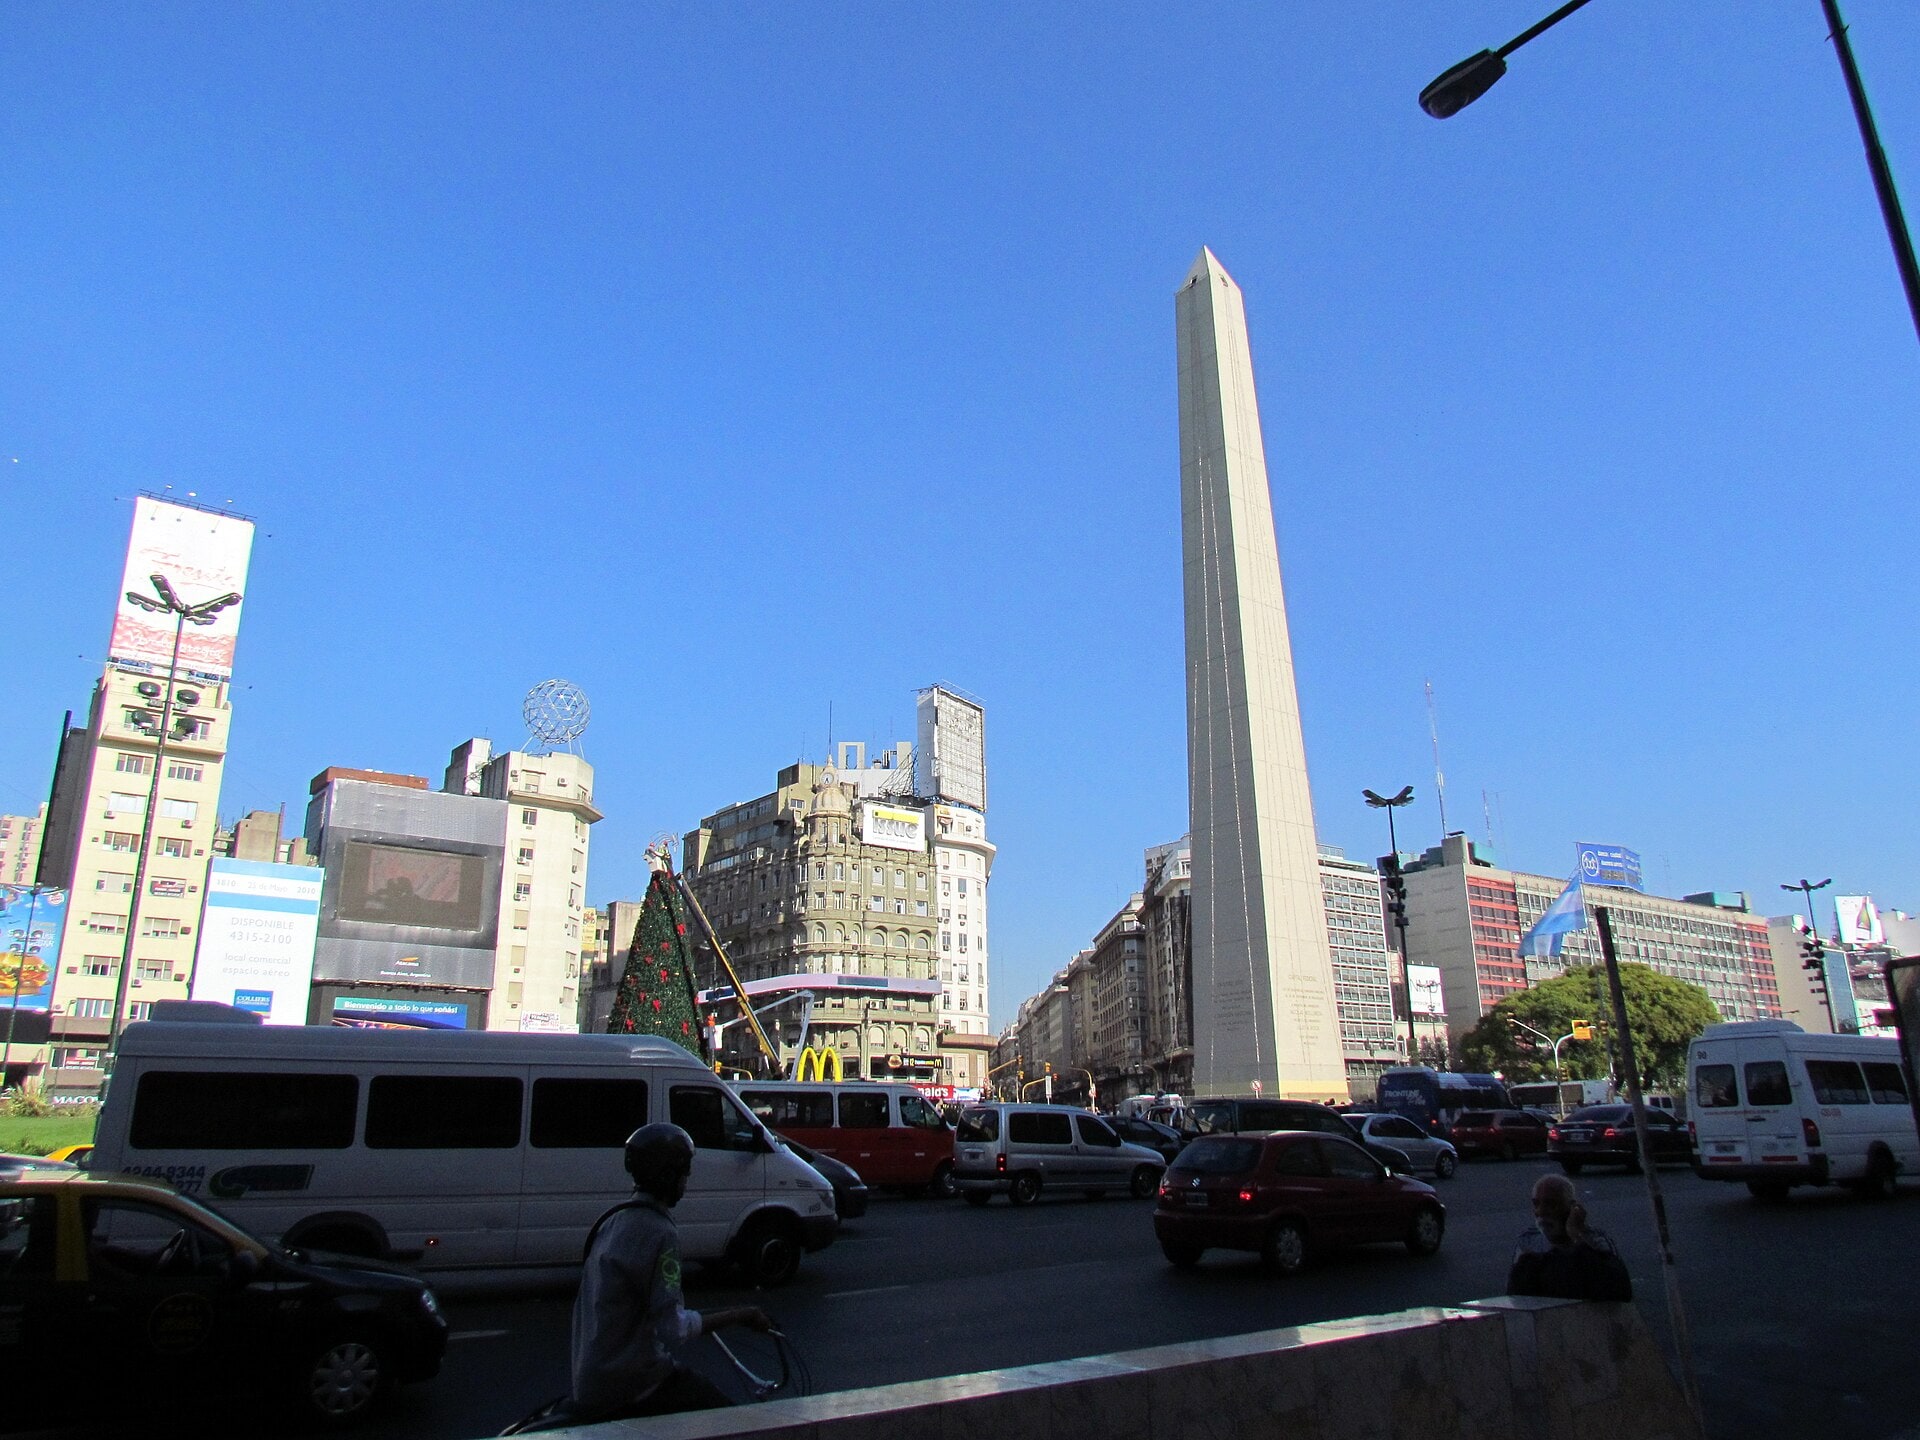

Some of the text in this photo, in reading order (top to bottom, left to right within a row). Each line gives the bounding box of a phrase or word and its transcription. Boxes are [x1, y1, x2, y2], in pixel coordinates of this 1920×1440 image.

[216, 879, 237, 888] 1810
[258, 883, 267, 891] de
[268, 883, 289, 894] Mayo
[296, 886, 316, 895] 2010
[230, 917, 295, 930] DISPONIBLE
[229, 931, 293, 945] 4315-2100
[224, 952, 292, 965] local comercial
[222, 966, 260, 977] espacio
[343, 1001, 387, 1011] Bienvenido
[387, 1004, 393, 1012] a
[394, 1003, 411, 1012] todo
[412, 1005, 419, 1013] lo
[420, 1007, 434, 1015] que
